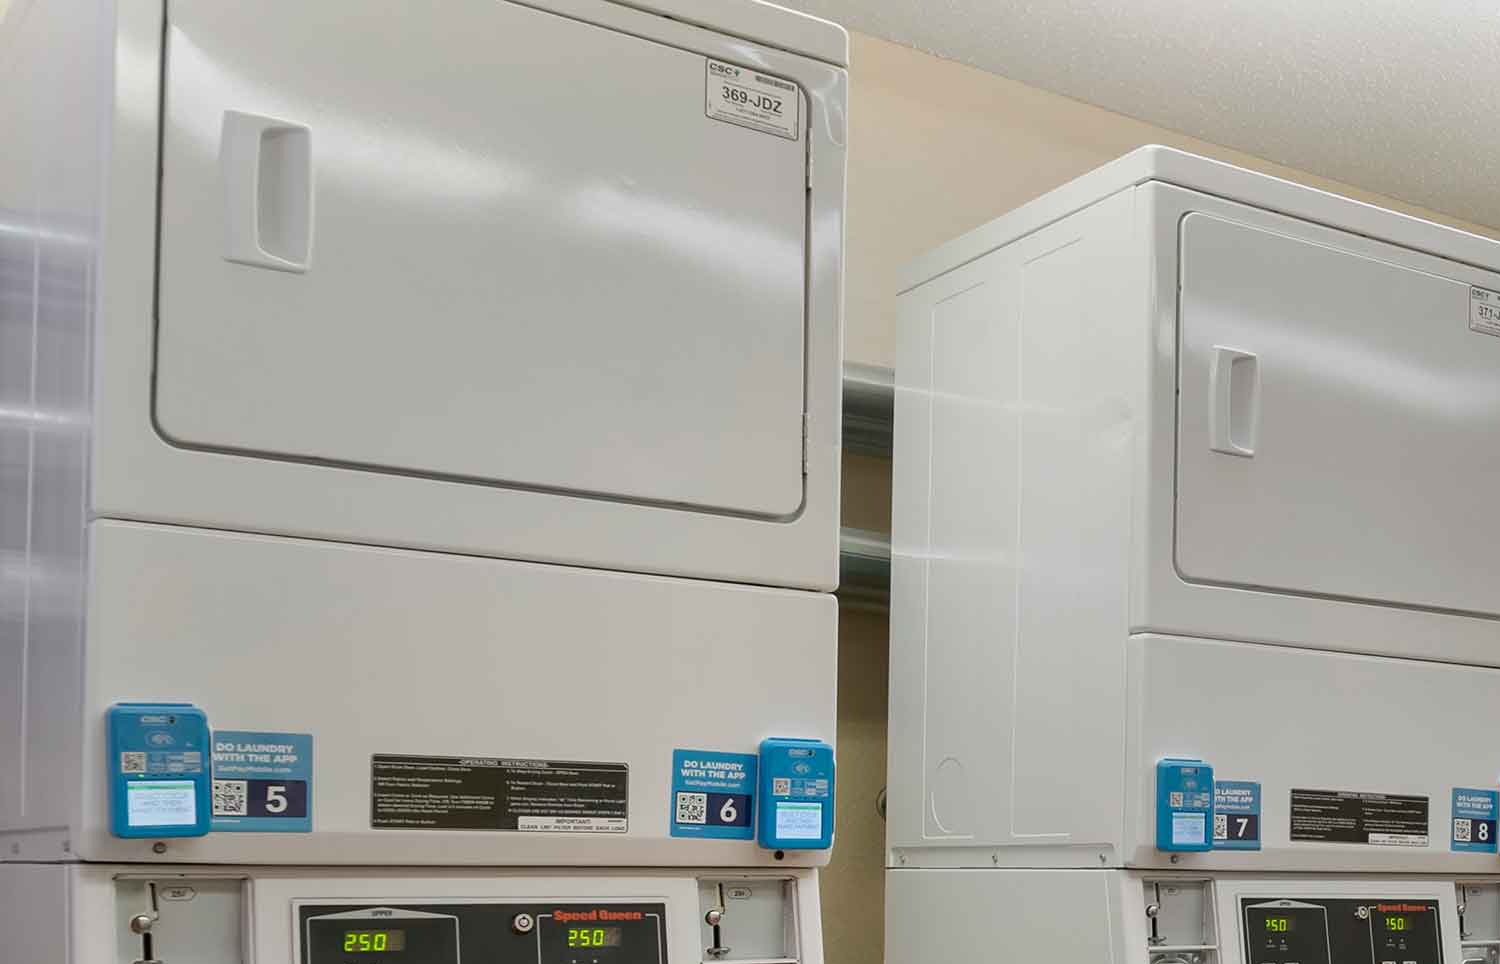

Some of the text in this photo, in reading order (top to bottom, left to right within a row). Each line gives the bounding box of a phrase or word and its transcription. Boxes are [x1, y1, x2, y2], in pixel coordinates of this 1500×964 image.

[709, 62, 733, 75] CSC
[722, 85, 782, 114] 369-JDZ
[215, 742, 294, 753] DO LAUNDRY
[211, 752, 298, 763] WITH THE APP
[684, 760, 744, 770] DO LAUNDRY
[681, 768, 746, 780] WITH THE APP
[265, 785, 288, 813] 5
[719, 798, 737, 823] 6
[1236, 818, 1249, 838] 7
[1478, 823, 1488, 841] 8
[553, 909, 642, 923] Speed Queen
[343, 933, 387, 952] 250
[567, 929, 605, 947] 250
